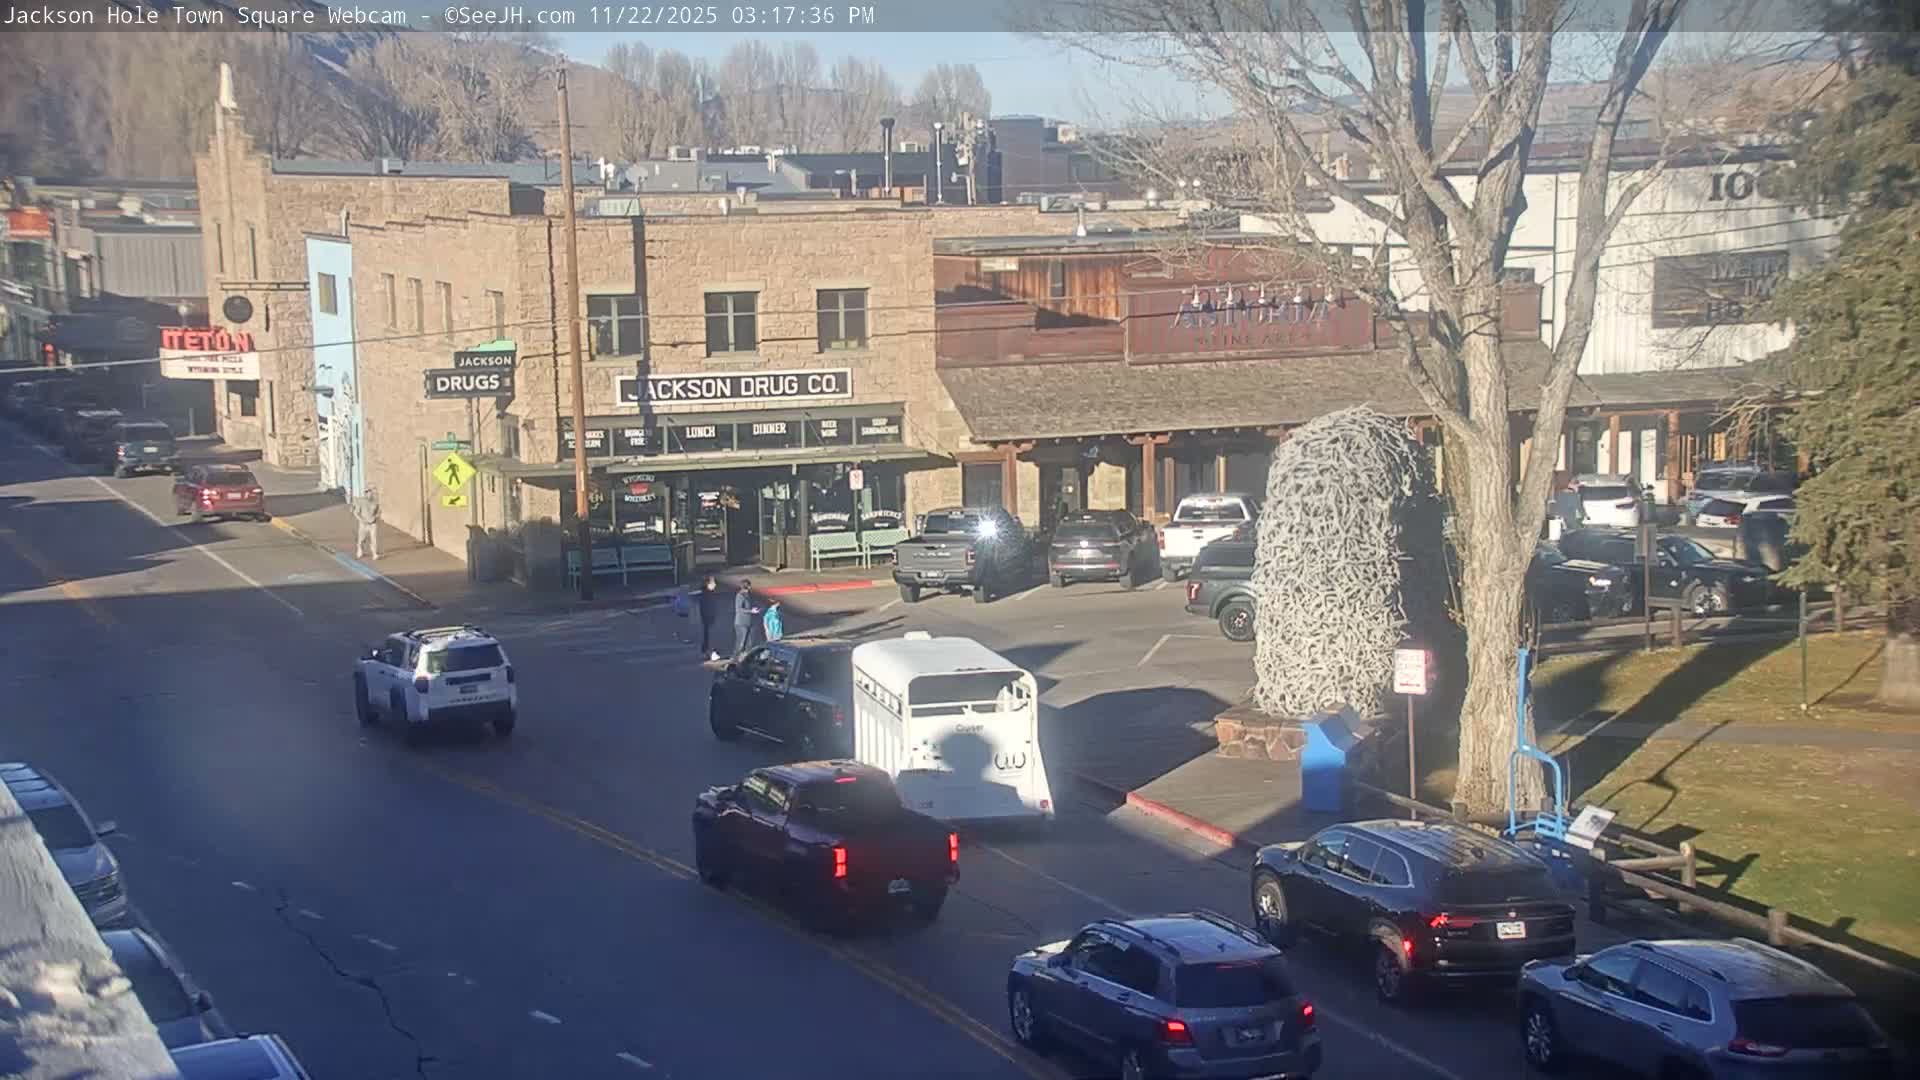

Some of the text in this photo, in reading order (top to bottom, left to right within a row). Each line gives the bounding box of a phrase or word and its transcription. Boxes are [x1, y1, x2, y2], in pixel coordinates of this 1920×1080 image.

[459, 356, 512, 367] JACKSON
[436, 374, 500, 392] DRUGS
[627, 374, 840, 401] JACKSON DRUG CO.
[685, 426, 716, 439] LUNCH
[752, 422, 787, 436] DINNER
